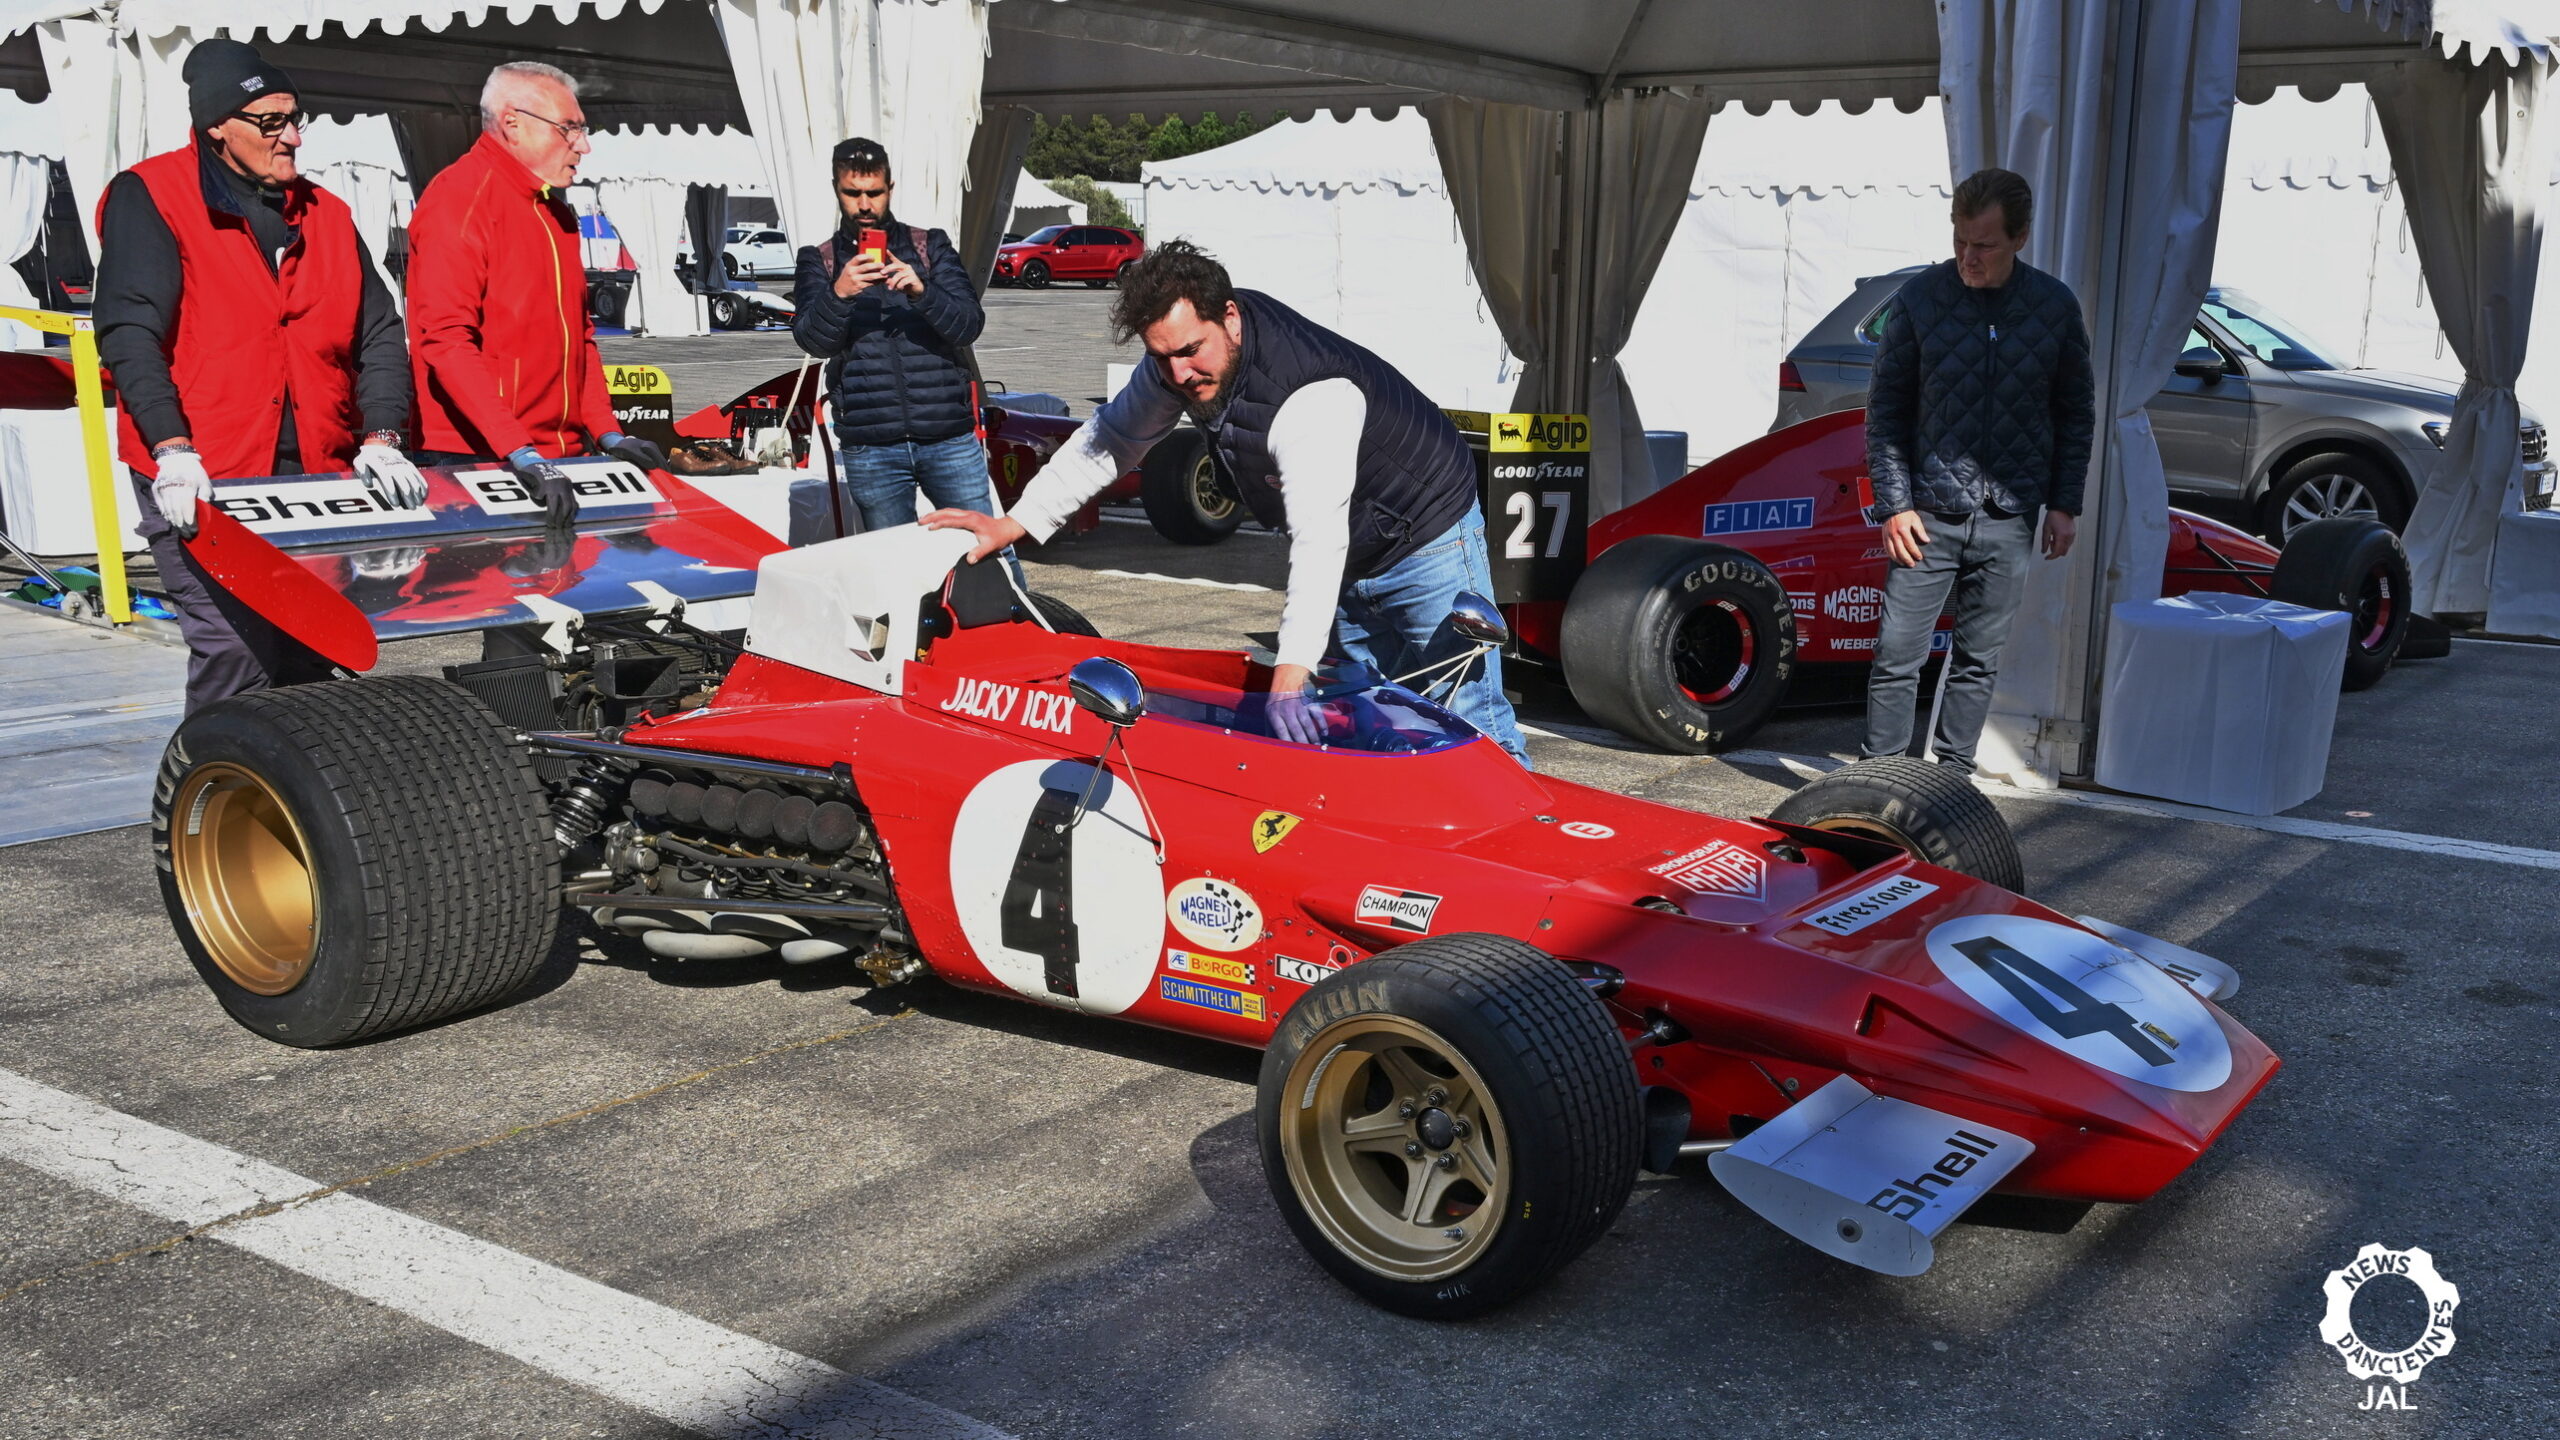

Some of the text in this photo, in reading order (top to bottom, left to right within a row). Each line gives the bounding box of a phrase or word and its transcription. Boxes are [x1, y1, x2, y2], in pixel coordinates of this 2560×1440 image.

[613, 367, 658, 393] Agip
[1526, 415, 1587, 450] Agip
[476, 472, 646, 507] Sell
[1494, 463, 1584, 481] GOODYEAR
[214, 489, 409, 523] Shel
[1713, 503, 1807, 529] FIAT
[1506, 491, 1571, 559] 27
[940, 677, 1077, 735] JACKY ICKX
[1648, 839, 1728, 875] CHRONOGRAPH
[1678, 850, 1757, 894] HEUER
[1000, 787, 1080, 999] 4
[1362, 895, 1430, 919] CHAMPION
[1816, 879, 1922, 931] Firestone
[1191, 957, 1242, 978] BORGO
[1163, 981, 1241, 1011] SCHMITTHELM
[1951, 936, 2176, 1067] 4
[1865, 1130, 1998, 1222] Shell
